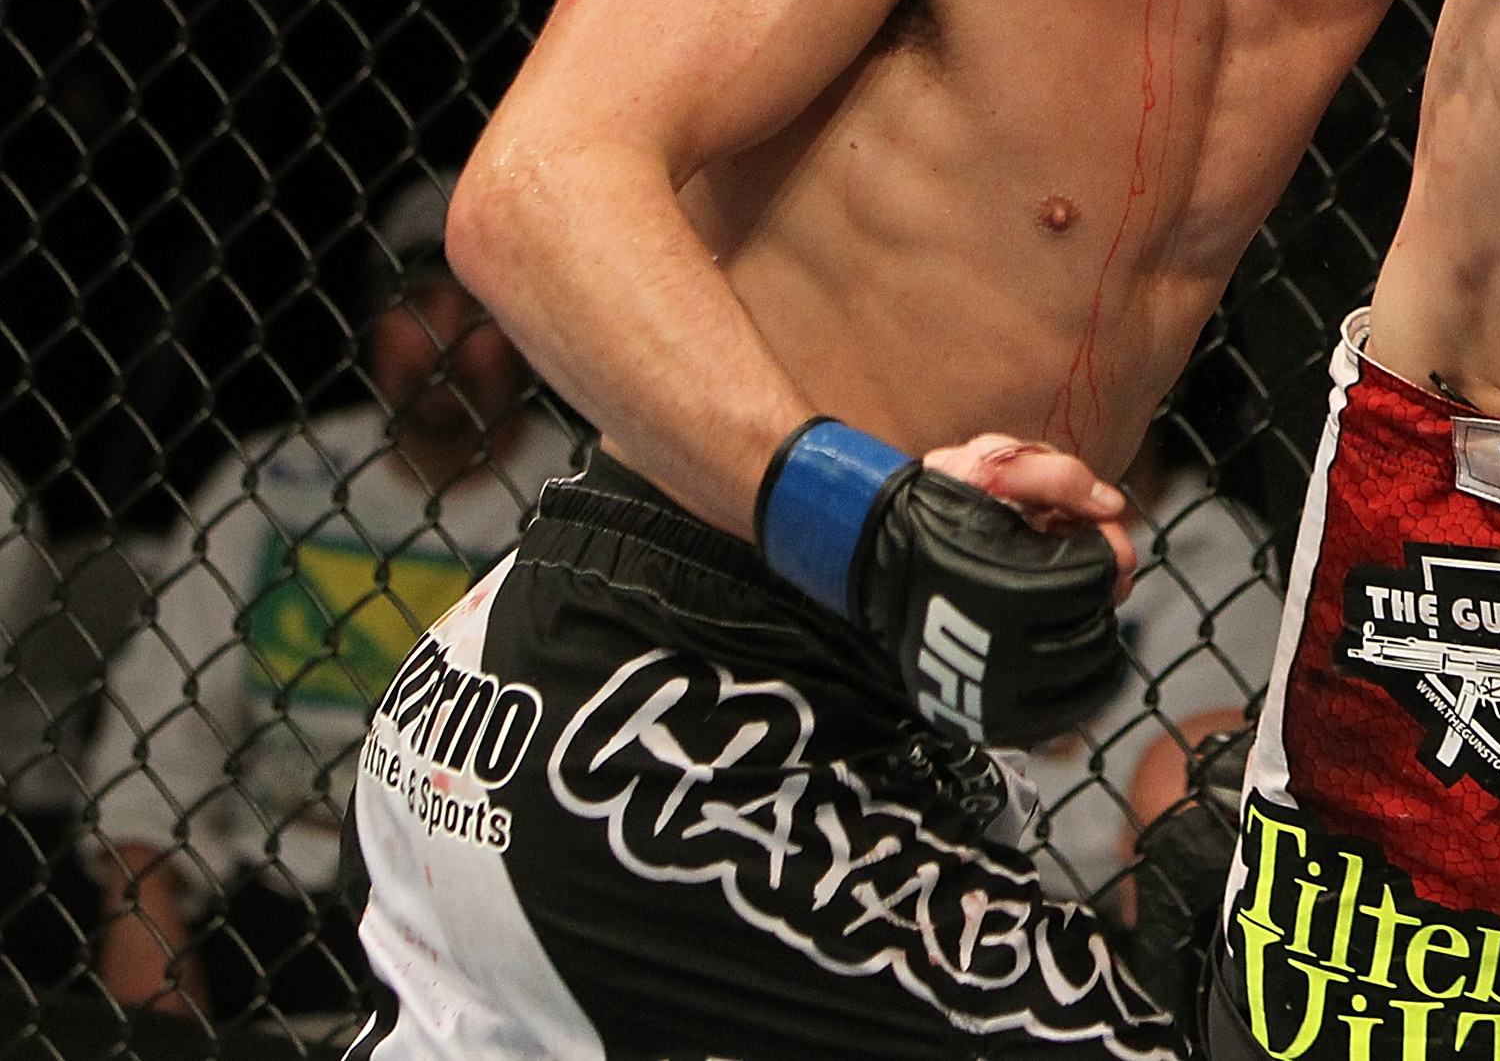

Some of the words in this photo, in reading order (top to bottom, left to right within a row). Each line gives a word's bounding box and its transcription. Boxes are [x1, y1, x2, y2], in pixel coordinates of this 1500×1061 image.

[1365, 585, 1438, 627] THE
[917, 594, 991, 742] UFC
[419, 776, 511, 848] Sports
